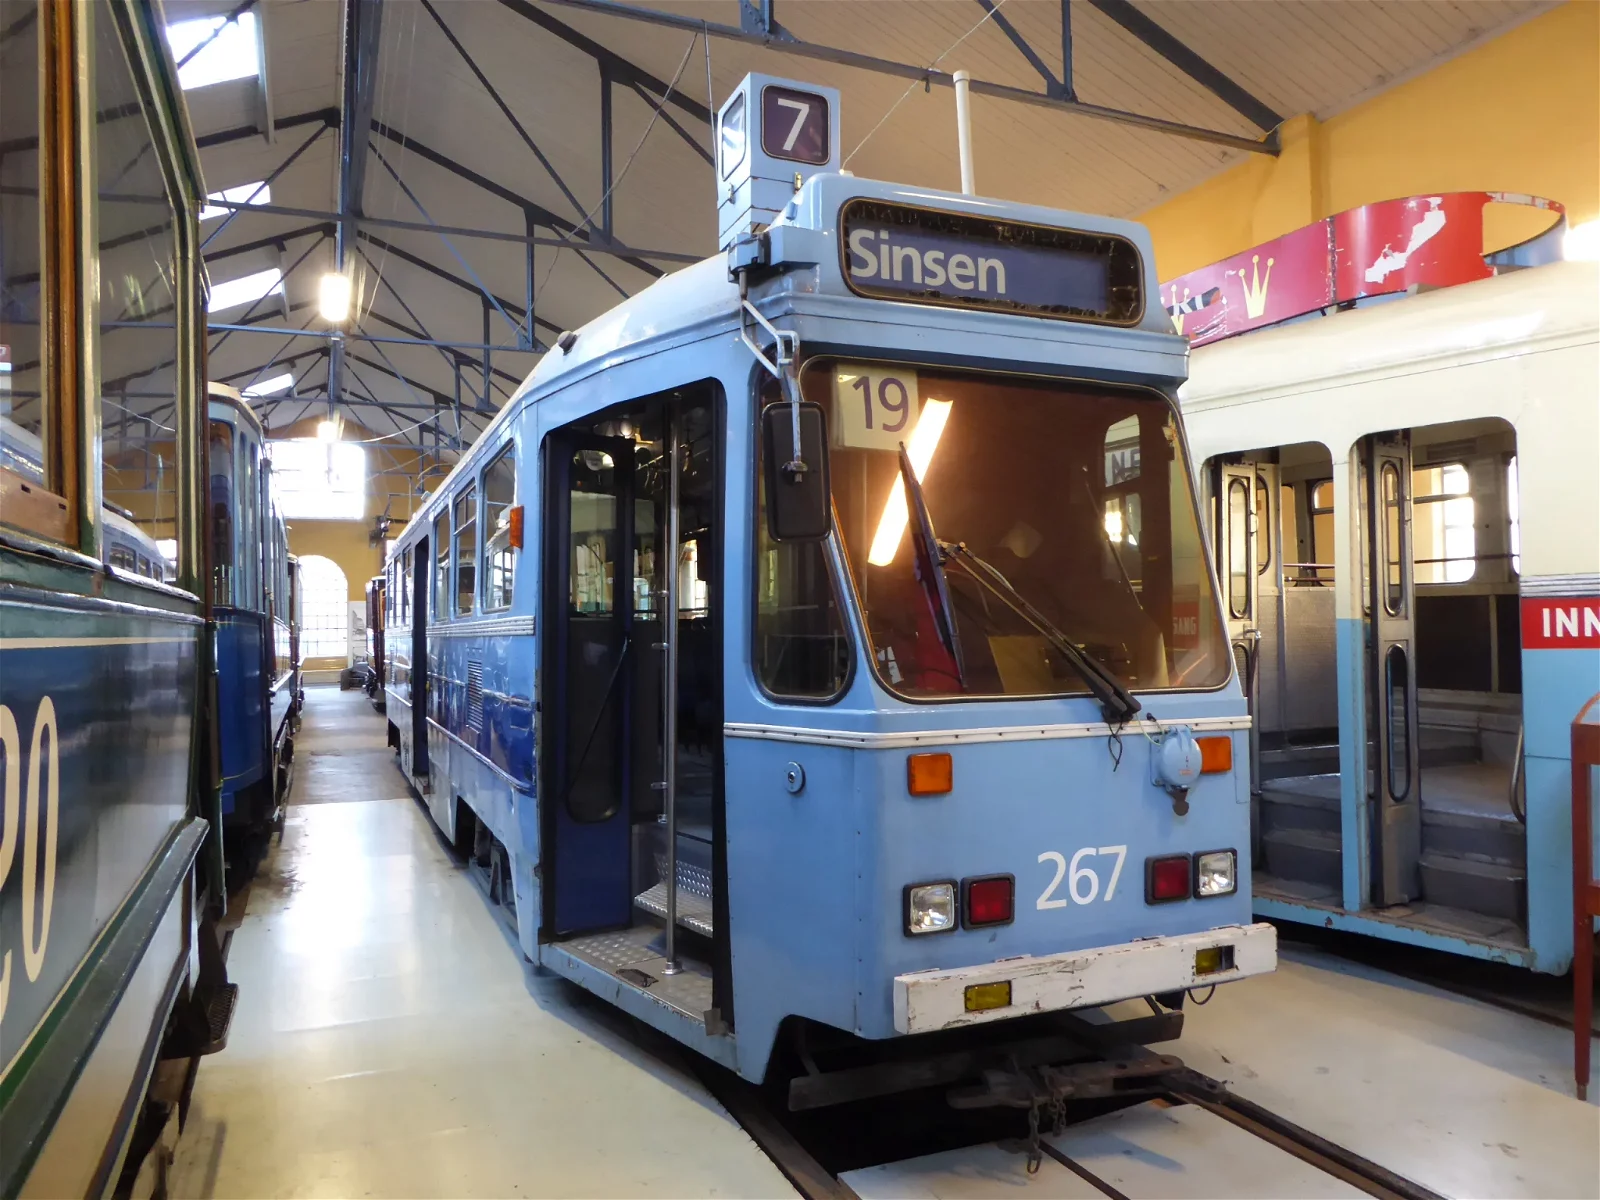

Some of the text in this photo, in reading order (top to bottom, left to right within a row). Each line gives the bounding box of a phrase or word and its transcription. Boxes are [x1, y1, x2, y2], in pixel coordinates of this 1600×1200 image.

[777, 97, 810, 152] 7
[848, 228, 1006, 295] Sinsen
[852, 375, 909, 433] 19
[1542, 606, 1600, 638] INN
[1036, 844, 1127, 910] 267
